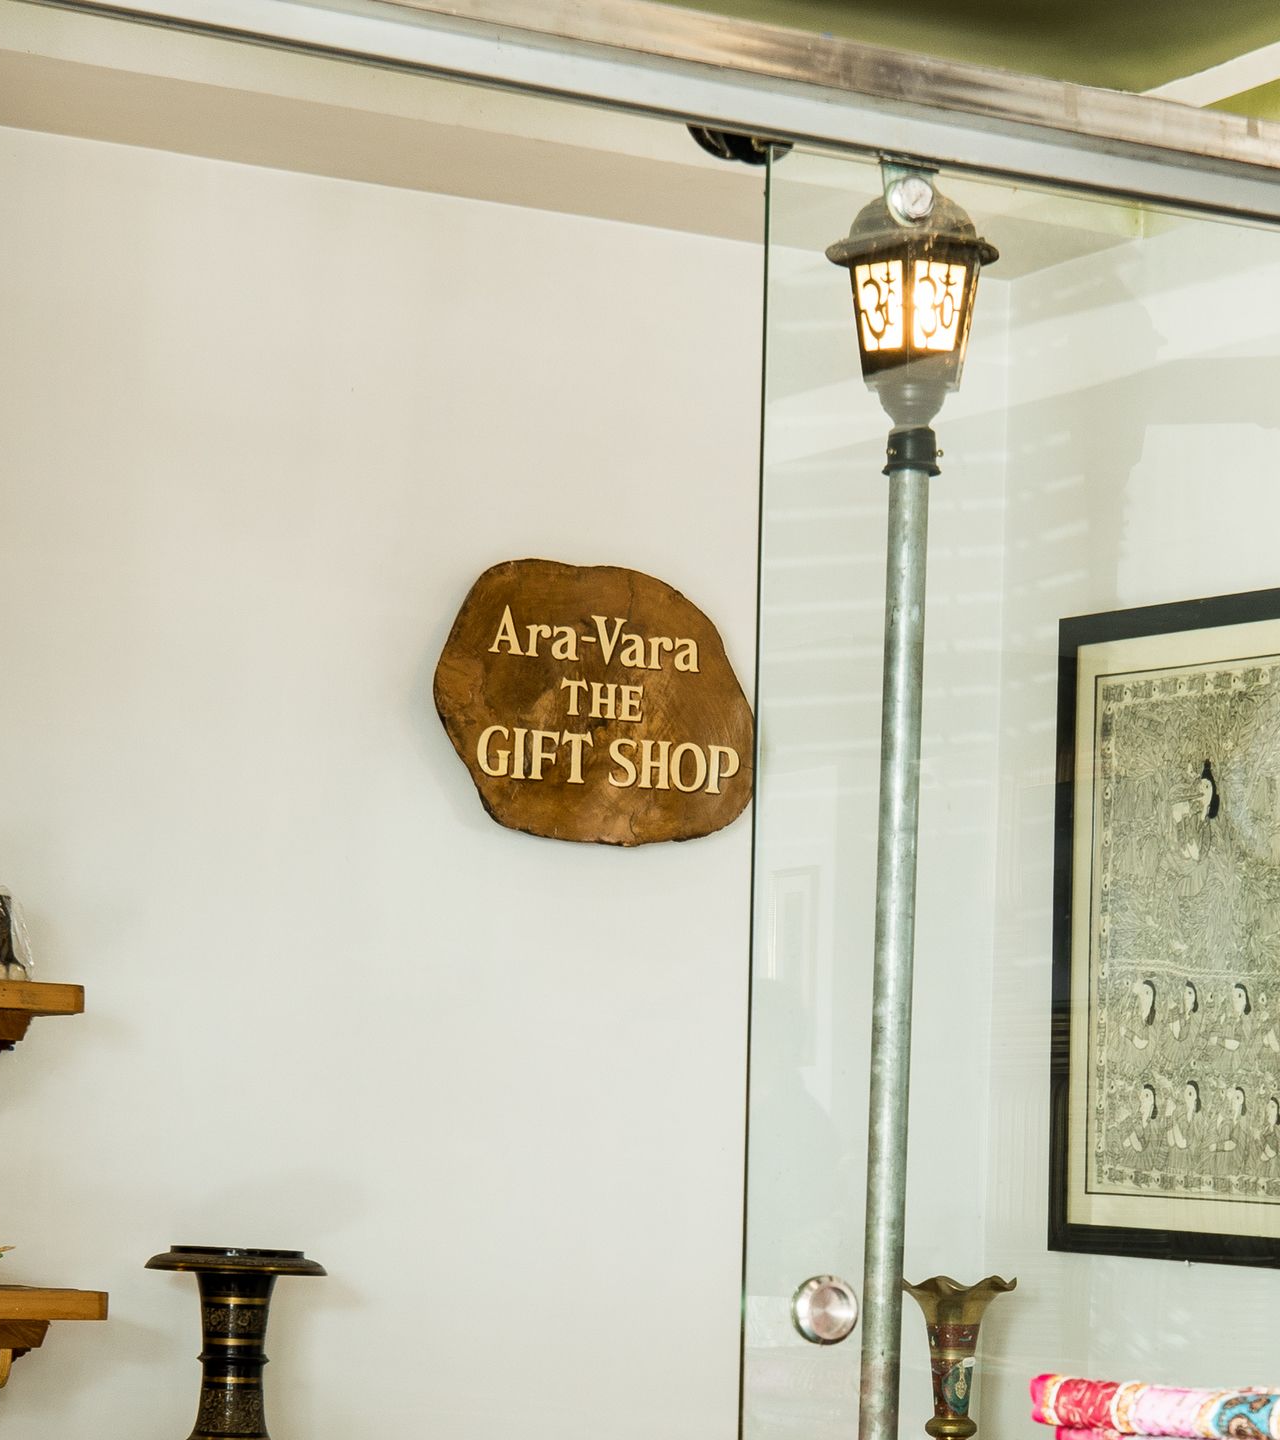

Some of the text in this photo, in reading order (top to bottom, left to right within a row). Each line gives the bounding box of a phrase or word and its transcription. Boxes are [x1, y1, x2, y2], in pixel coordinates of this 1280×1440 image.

[487, 603, 700, 673] Ara-Vara
[560, 676, 644, 722] THE
[476, 725, 740, 794] GIFT SHOP
